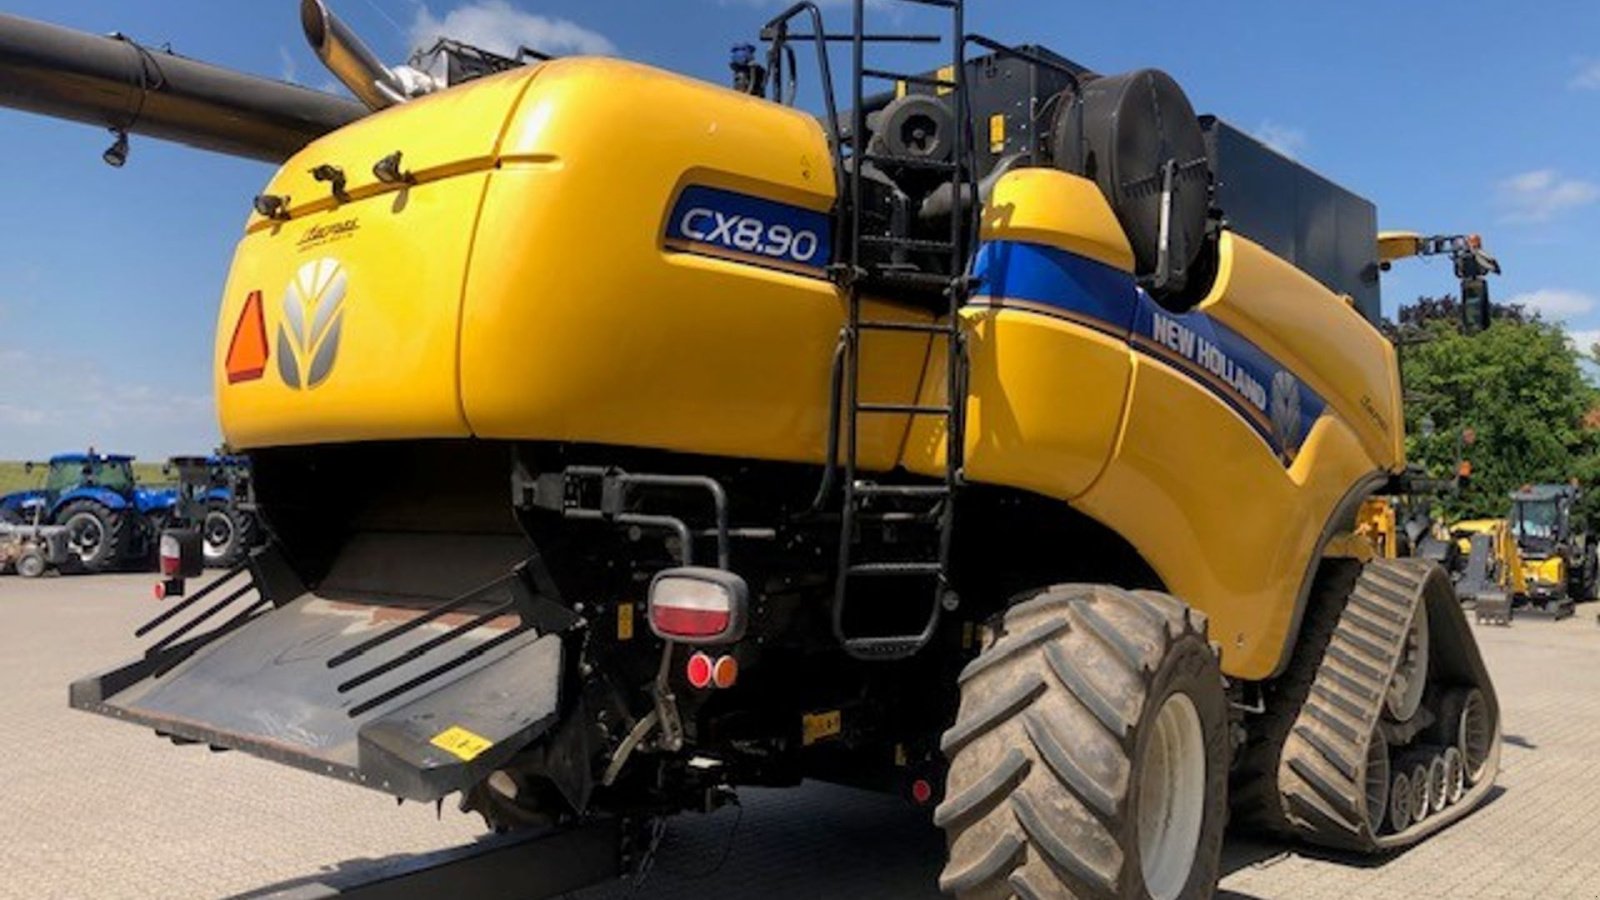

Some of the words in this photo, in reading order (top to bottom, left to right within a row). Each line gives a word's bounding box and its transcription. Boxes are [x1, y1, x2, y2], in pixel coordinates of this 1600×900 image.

[680, 207, 818, 261] CX8.90
[1152, 312, 1195, 359] NEW
[1197, 336, 1267, 411] HOLLAND
